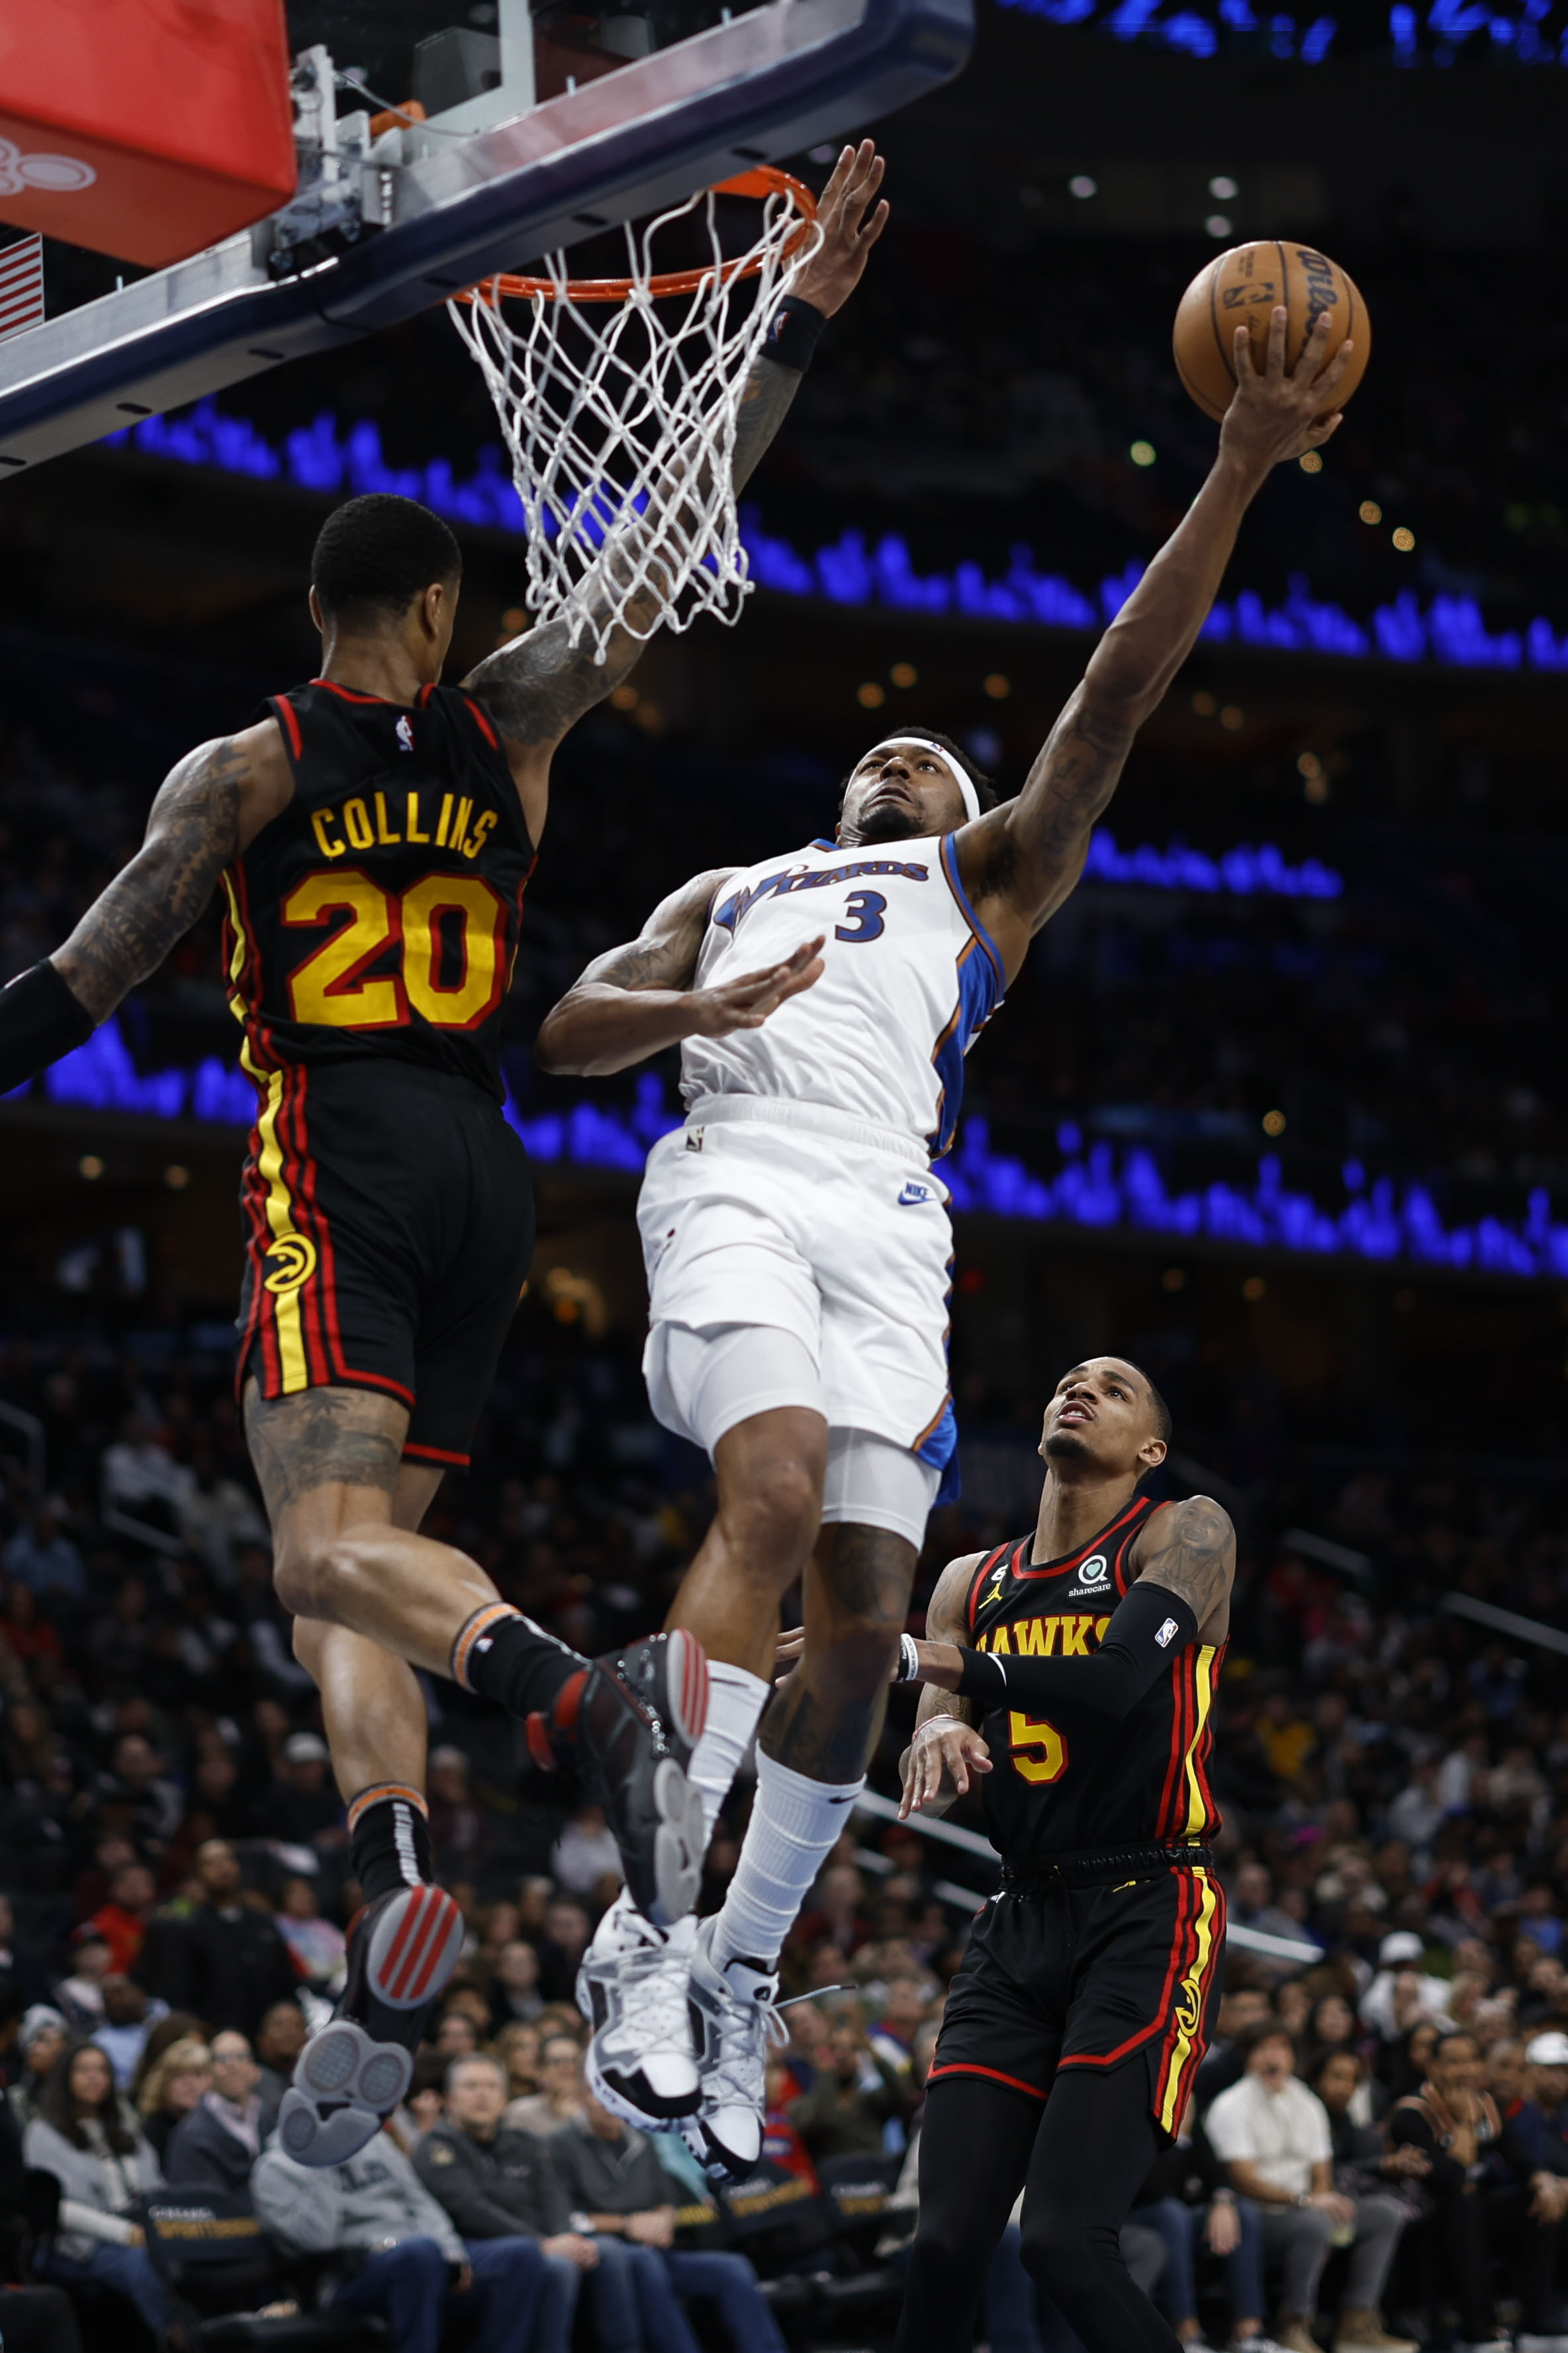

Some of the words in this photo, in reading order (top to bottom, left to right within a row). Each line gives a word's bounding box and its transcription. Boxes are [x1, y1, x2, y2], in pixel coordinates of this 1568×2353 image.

[1297, 250, 1338, 344] Wils
[311, 791, 498, 859] COLLINS
[280, 867, 509, 1030] 20
[835, 889, 887, 943] 3
[991, 1564, 1009, 1581] 6
[1068, 1582, 1112, 1597] sharecare
[1008, 1710, 1069, 1786] 5
